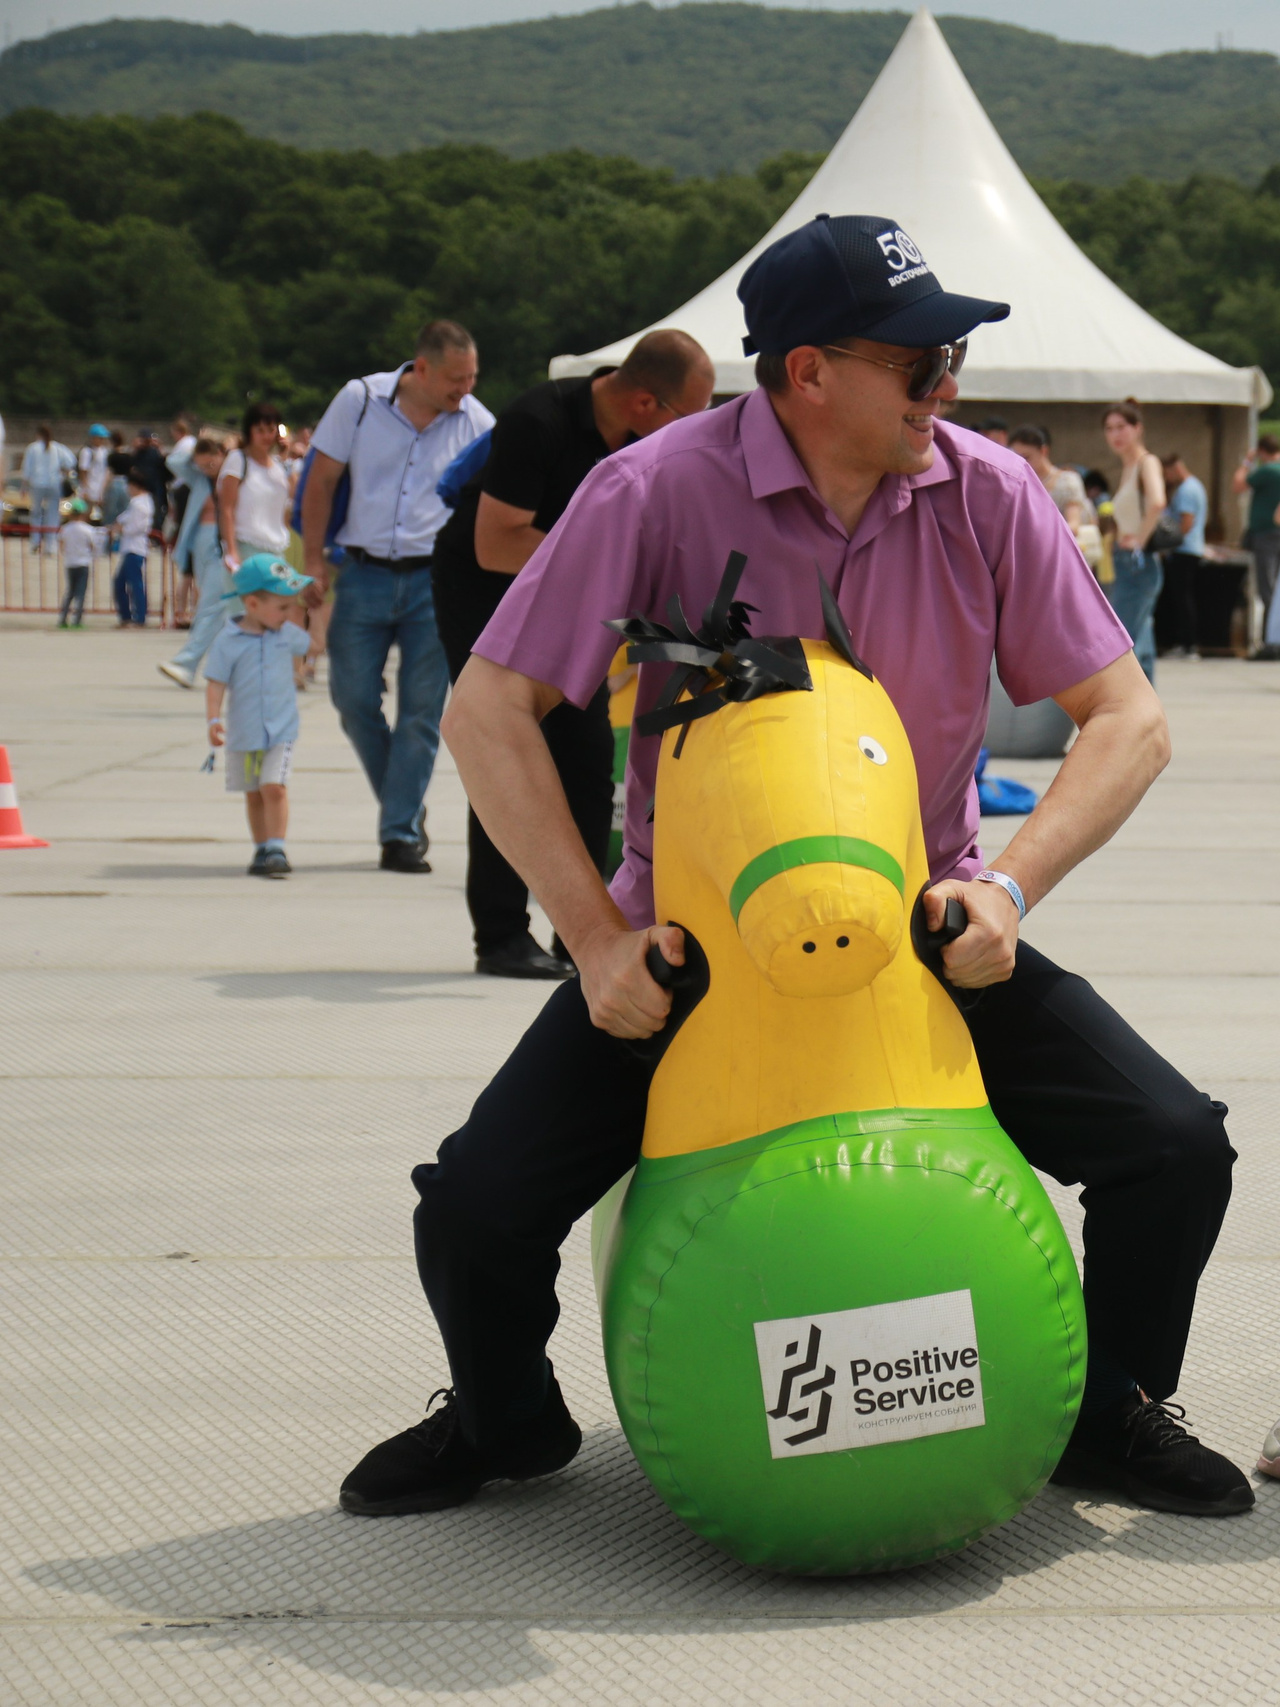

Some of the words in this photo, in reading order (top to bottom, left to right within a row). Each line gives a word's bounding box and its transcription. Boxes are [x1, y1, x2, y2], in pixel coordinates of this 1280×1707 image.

[850, 1347, 978, 1386] Positive
[853, 1378, 975, 1416] Service
[858, 1412, 933, 1429] КОНСТРУИРУЕМ
[934, 1404, 977, 1418] СОБЫТИЯ
